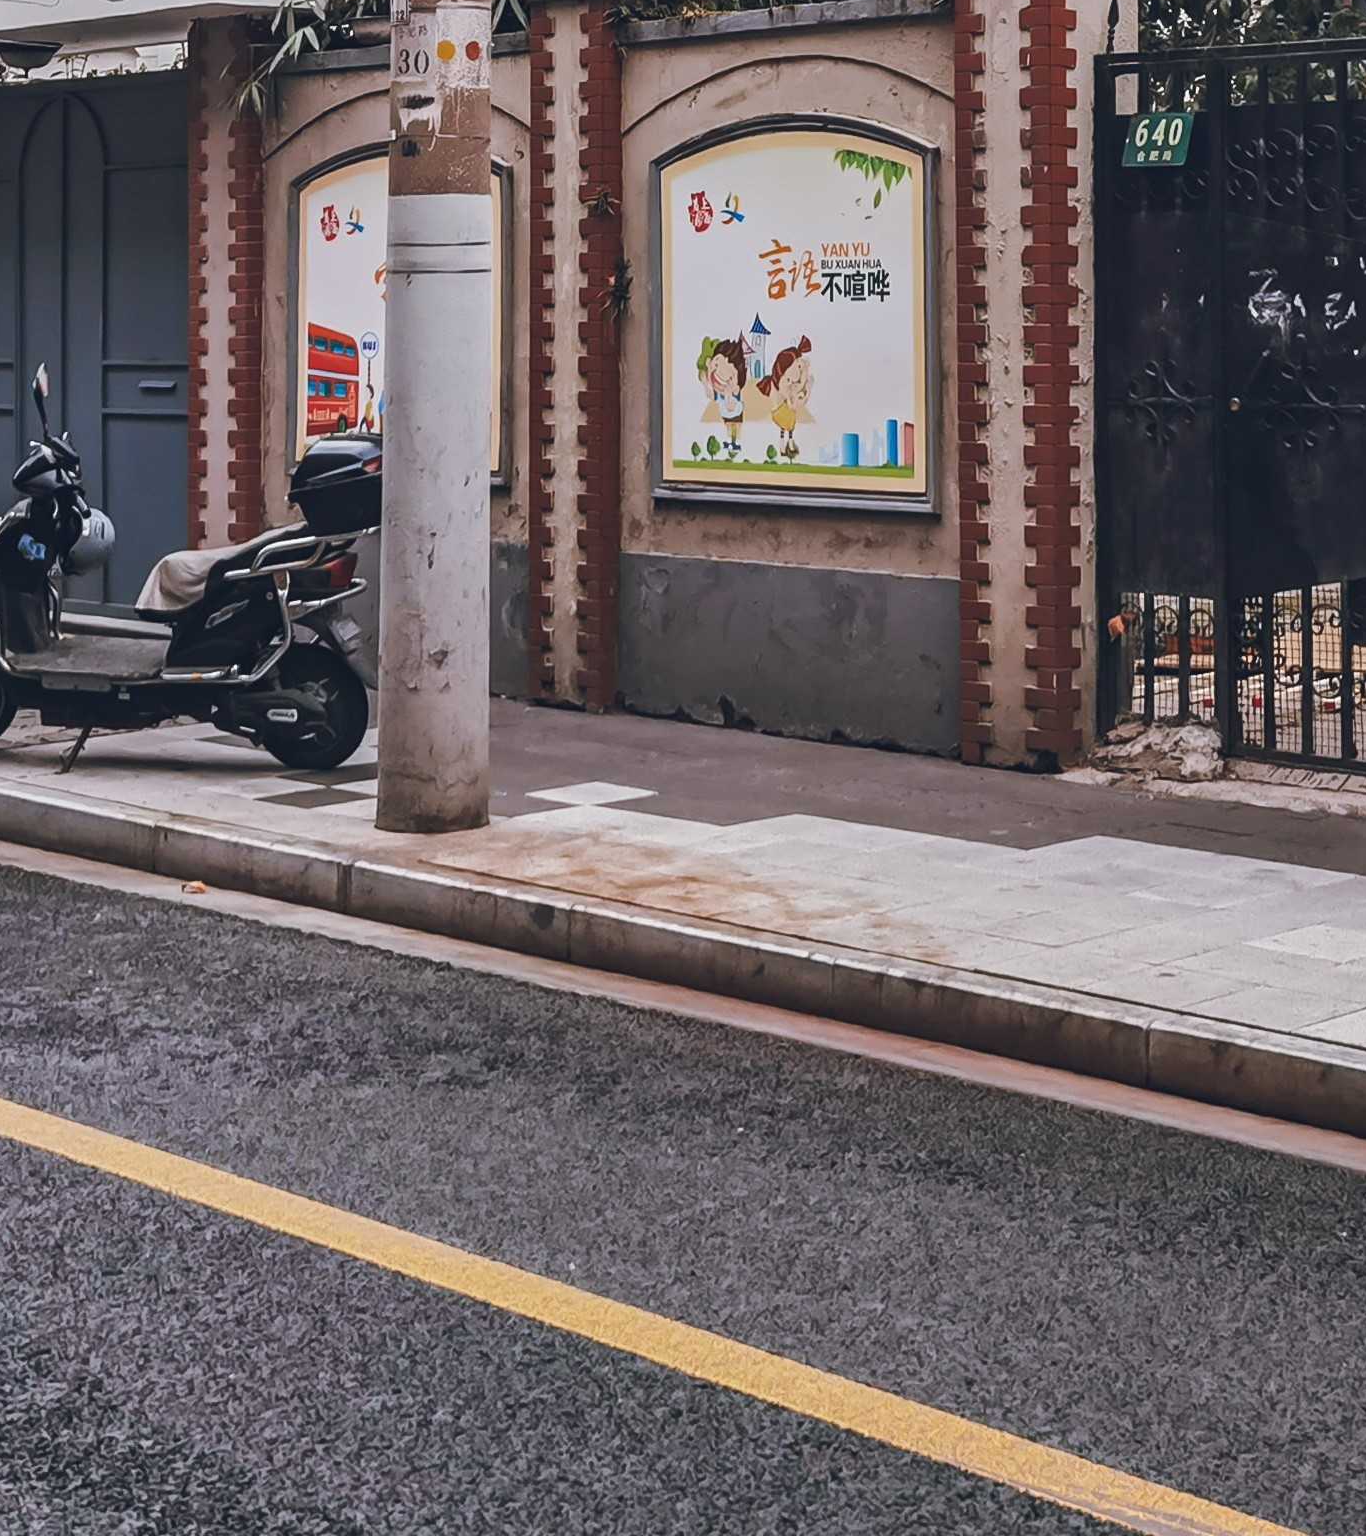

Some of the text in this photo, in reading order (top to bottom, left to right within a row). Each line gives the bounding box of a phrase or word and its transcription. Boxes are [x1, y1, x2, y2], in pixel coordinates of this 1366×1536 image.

[398, 48, 430, 74] 30
[1135, 118, 1184, 147] 640
[821, 242, 870, 257] YAN YU
[820, 258, 882, 270] BU XUAN HUA
[820, 269, 891, 303] 不喧哗
